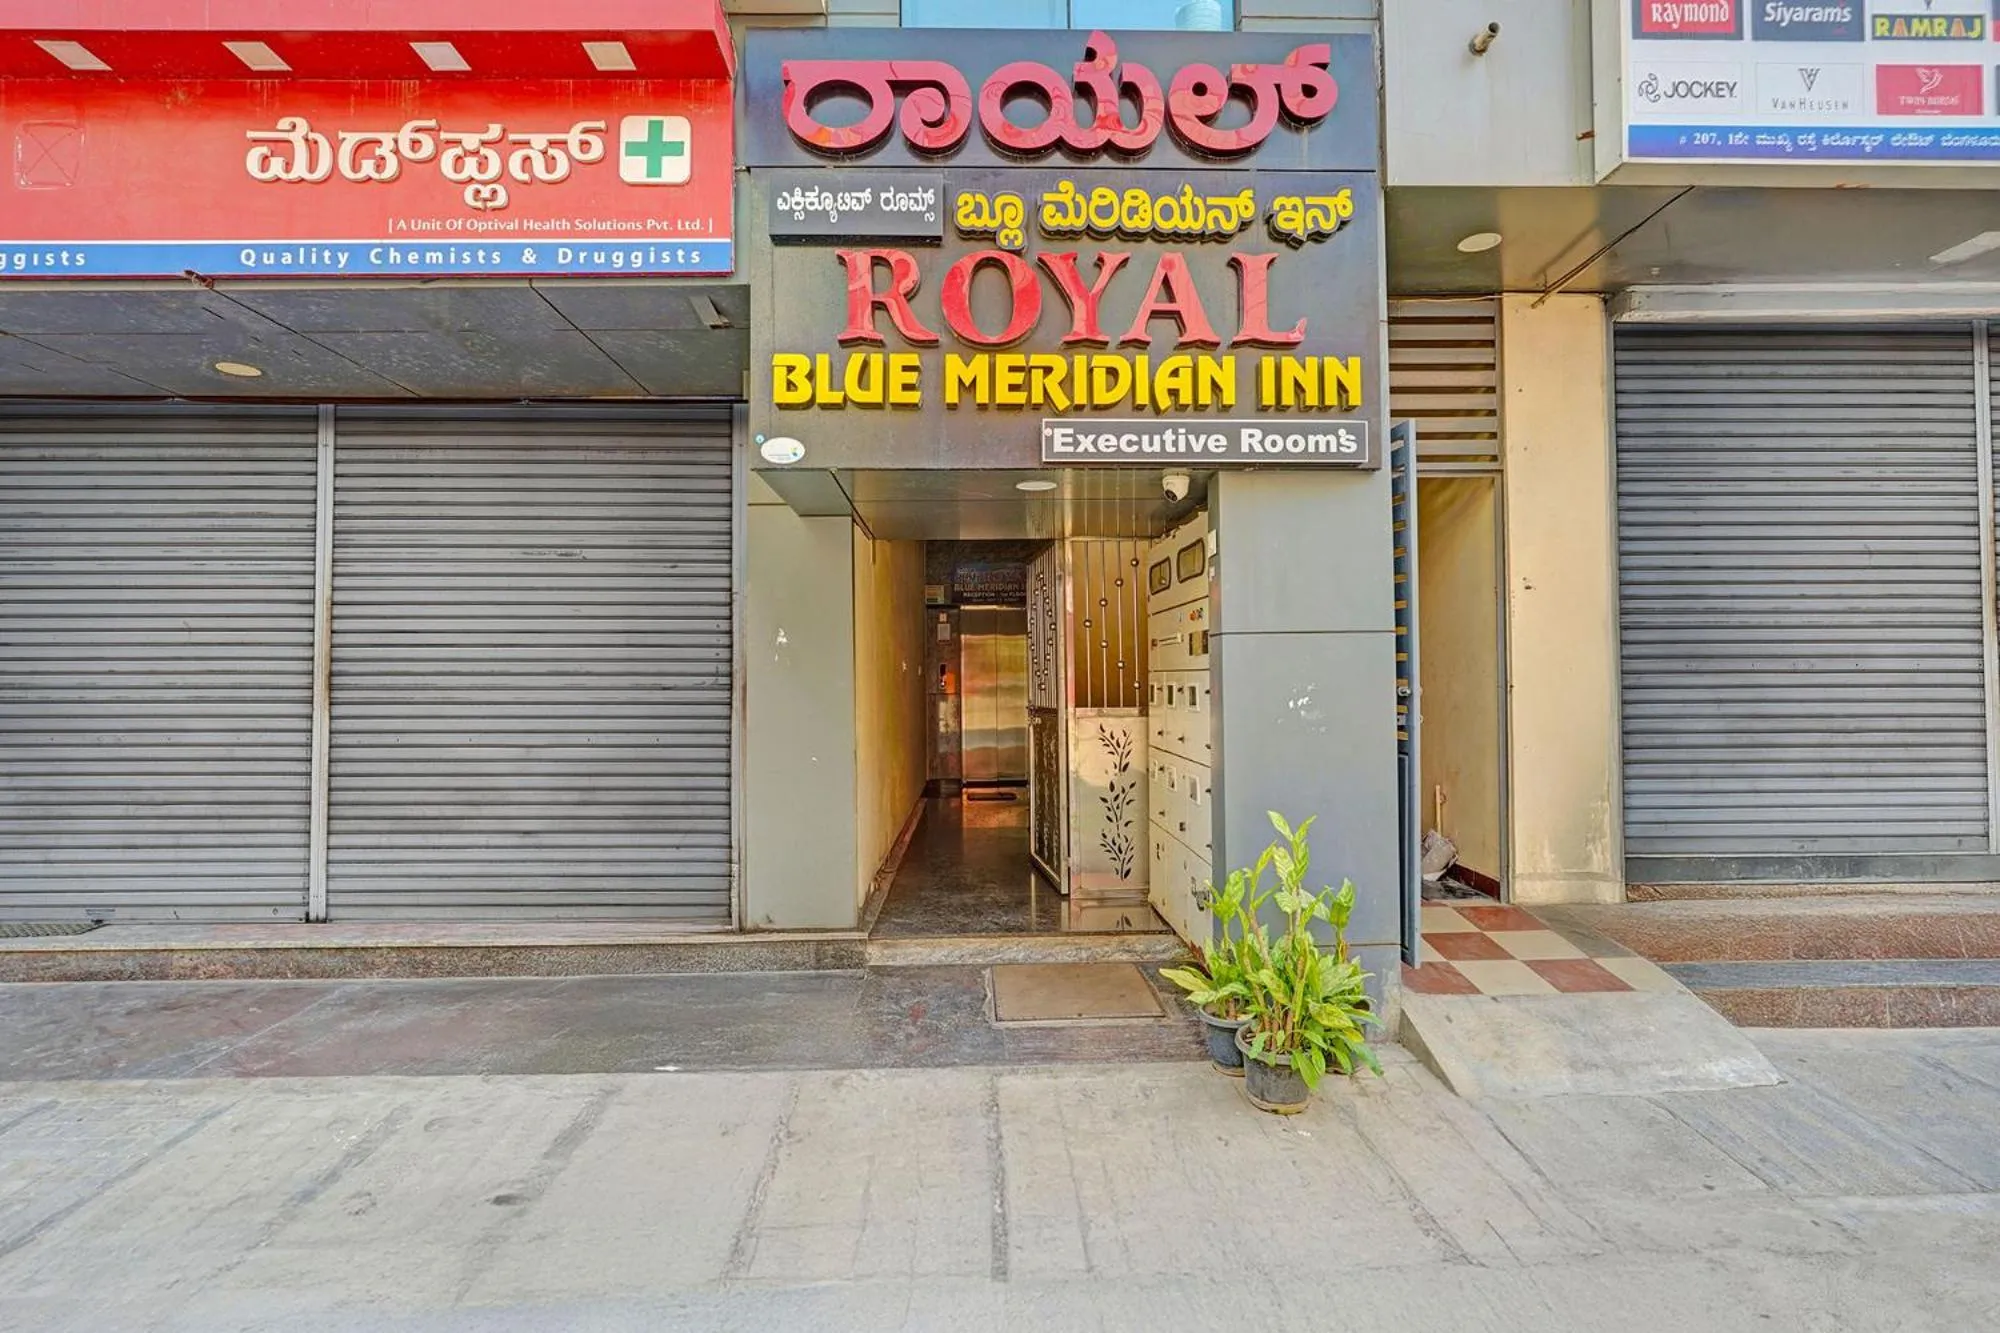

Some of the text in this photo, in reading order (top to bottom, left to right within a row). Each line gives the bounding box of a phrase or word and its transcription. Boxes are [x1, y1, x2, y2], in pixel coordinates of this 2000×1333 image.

[1652, 0, 1729, 29] Raymond
[1875, 17, 1981, 38] RAMRAJ
[1664, 81, 1737, 98] JOCKEY
[1272, 188, 1354, 237] ಇನ್
[396, 219, 704, 233] A Unit Of Optival Health Solutions Pvt. Ltd.
[240, 248, 701, 269] Quality Chemists & Druggists
[835, 248, 1308, 347] ROYAL
[771, 352, 1362, 414] BLUE MERIDIAN INN
[1053, 427, 1229, 453] Executive
